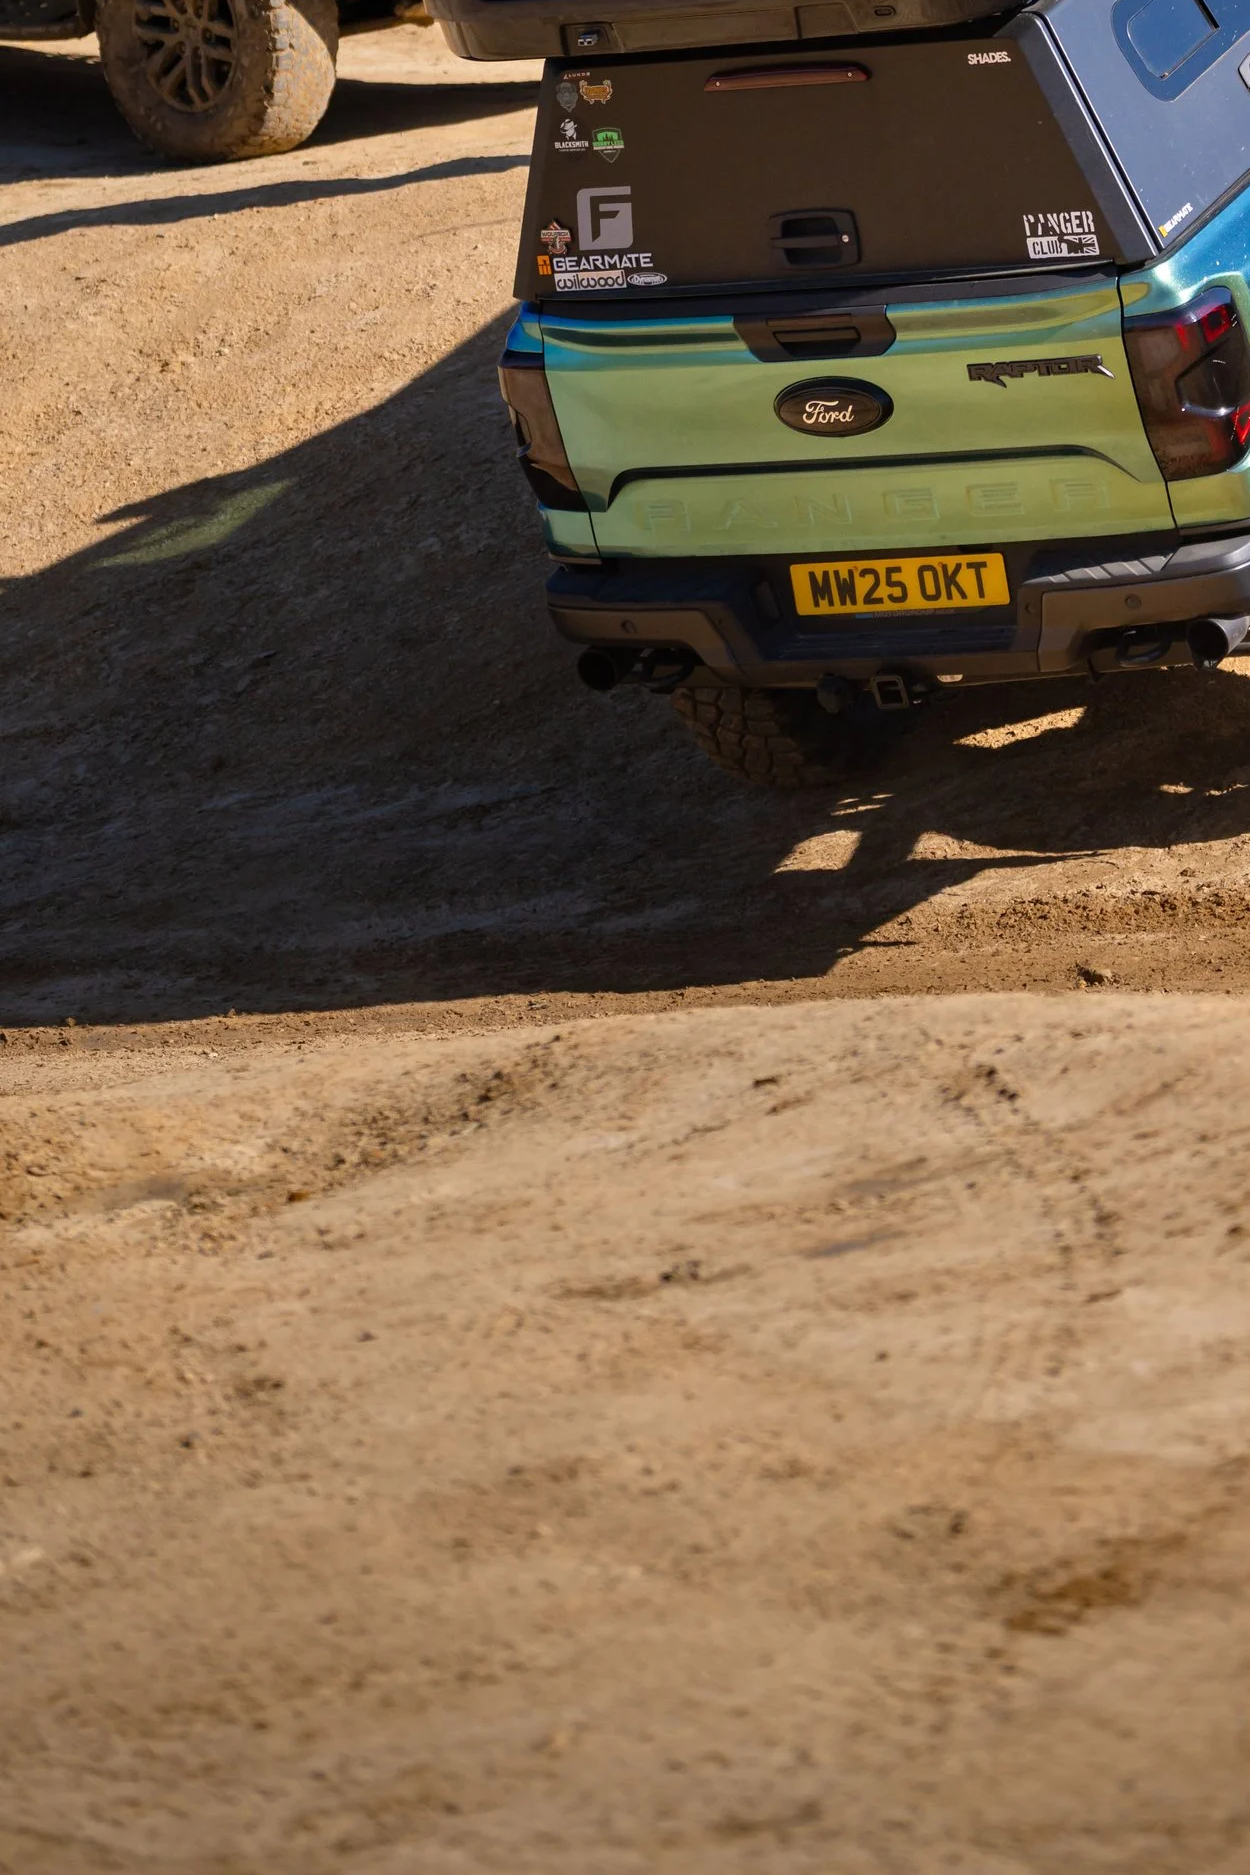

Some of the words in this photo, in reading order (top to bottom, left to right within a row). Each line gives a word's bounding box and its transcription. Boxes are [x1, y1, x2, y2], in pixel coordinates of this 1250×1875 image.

[967, 51, 1012, 65] SHADES.
[554, 140, 590, 149] BLACKSMITH
[1032, 240, 1063, 256] CLUB
[552, 252, 654, 272] GEARMATE
[555, 269, 626, 290] wilwood
[967, 355, 1115, 389] RAPTOR
[802, 400, 855, 424] Ford
[633, 477, 1110, 532] RANGER
[808, 566, 908, 609] MW25
[917, 561, 988, 603] OKT
